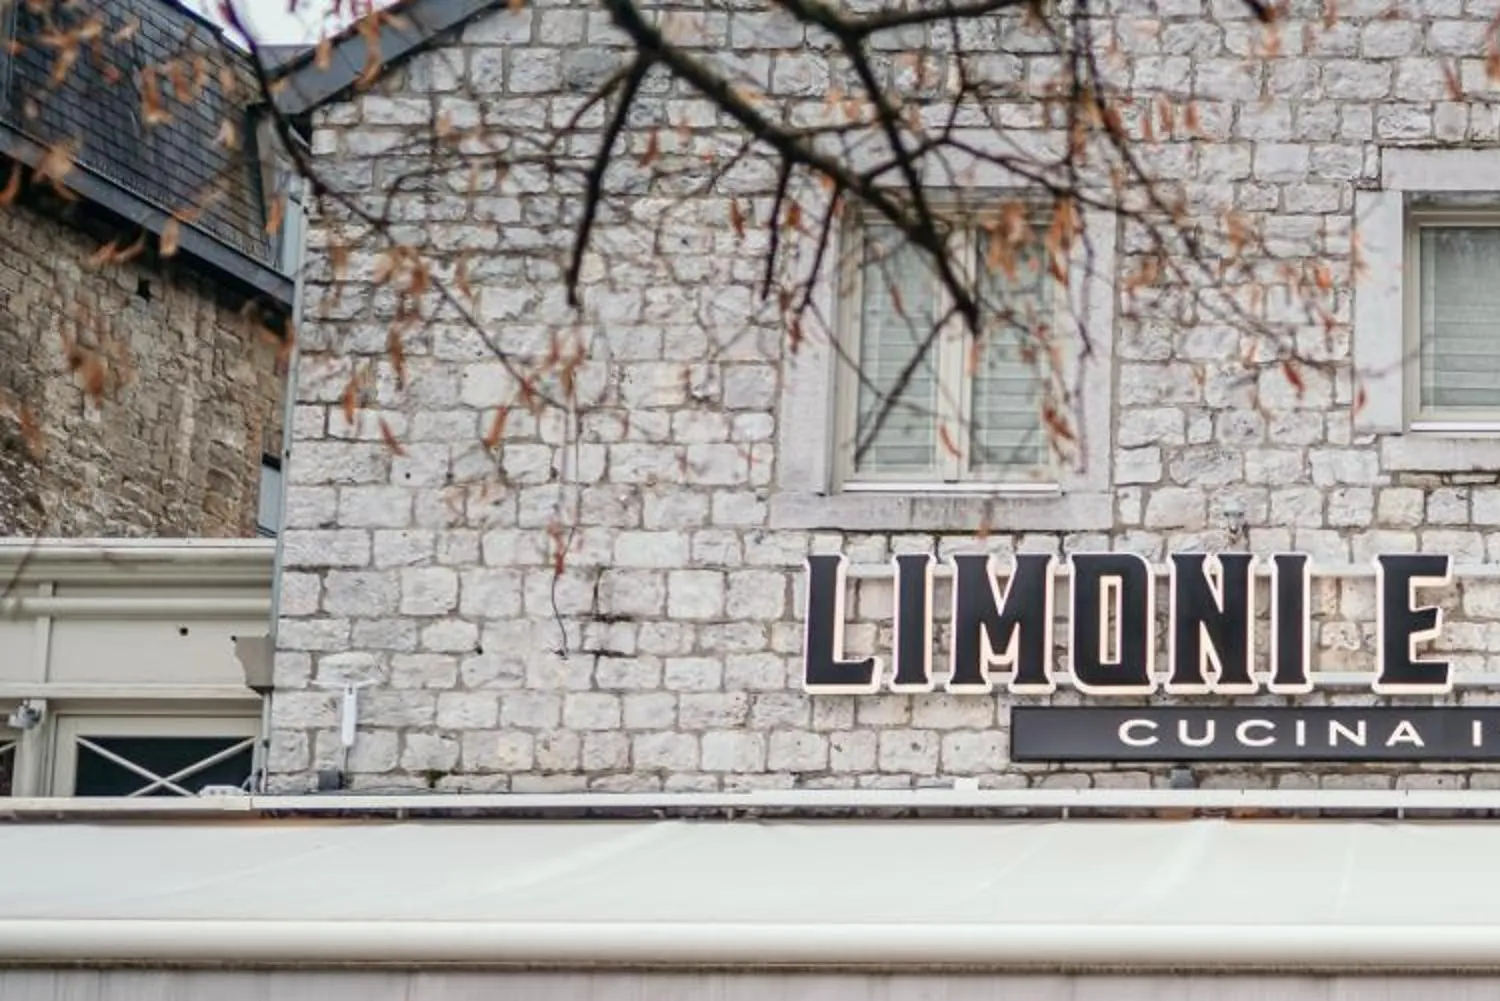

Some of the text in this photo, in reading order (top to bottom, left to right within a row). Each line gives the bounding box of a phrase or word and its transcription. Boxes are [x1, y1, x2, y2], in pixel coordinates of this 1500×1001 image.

[805, 552, 1312, 692] LIMONI
[1374, 552, 1451, 692] E
[1117, 718, 1426, 747] CUCINA
